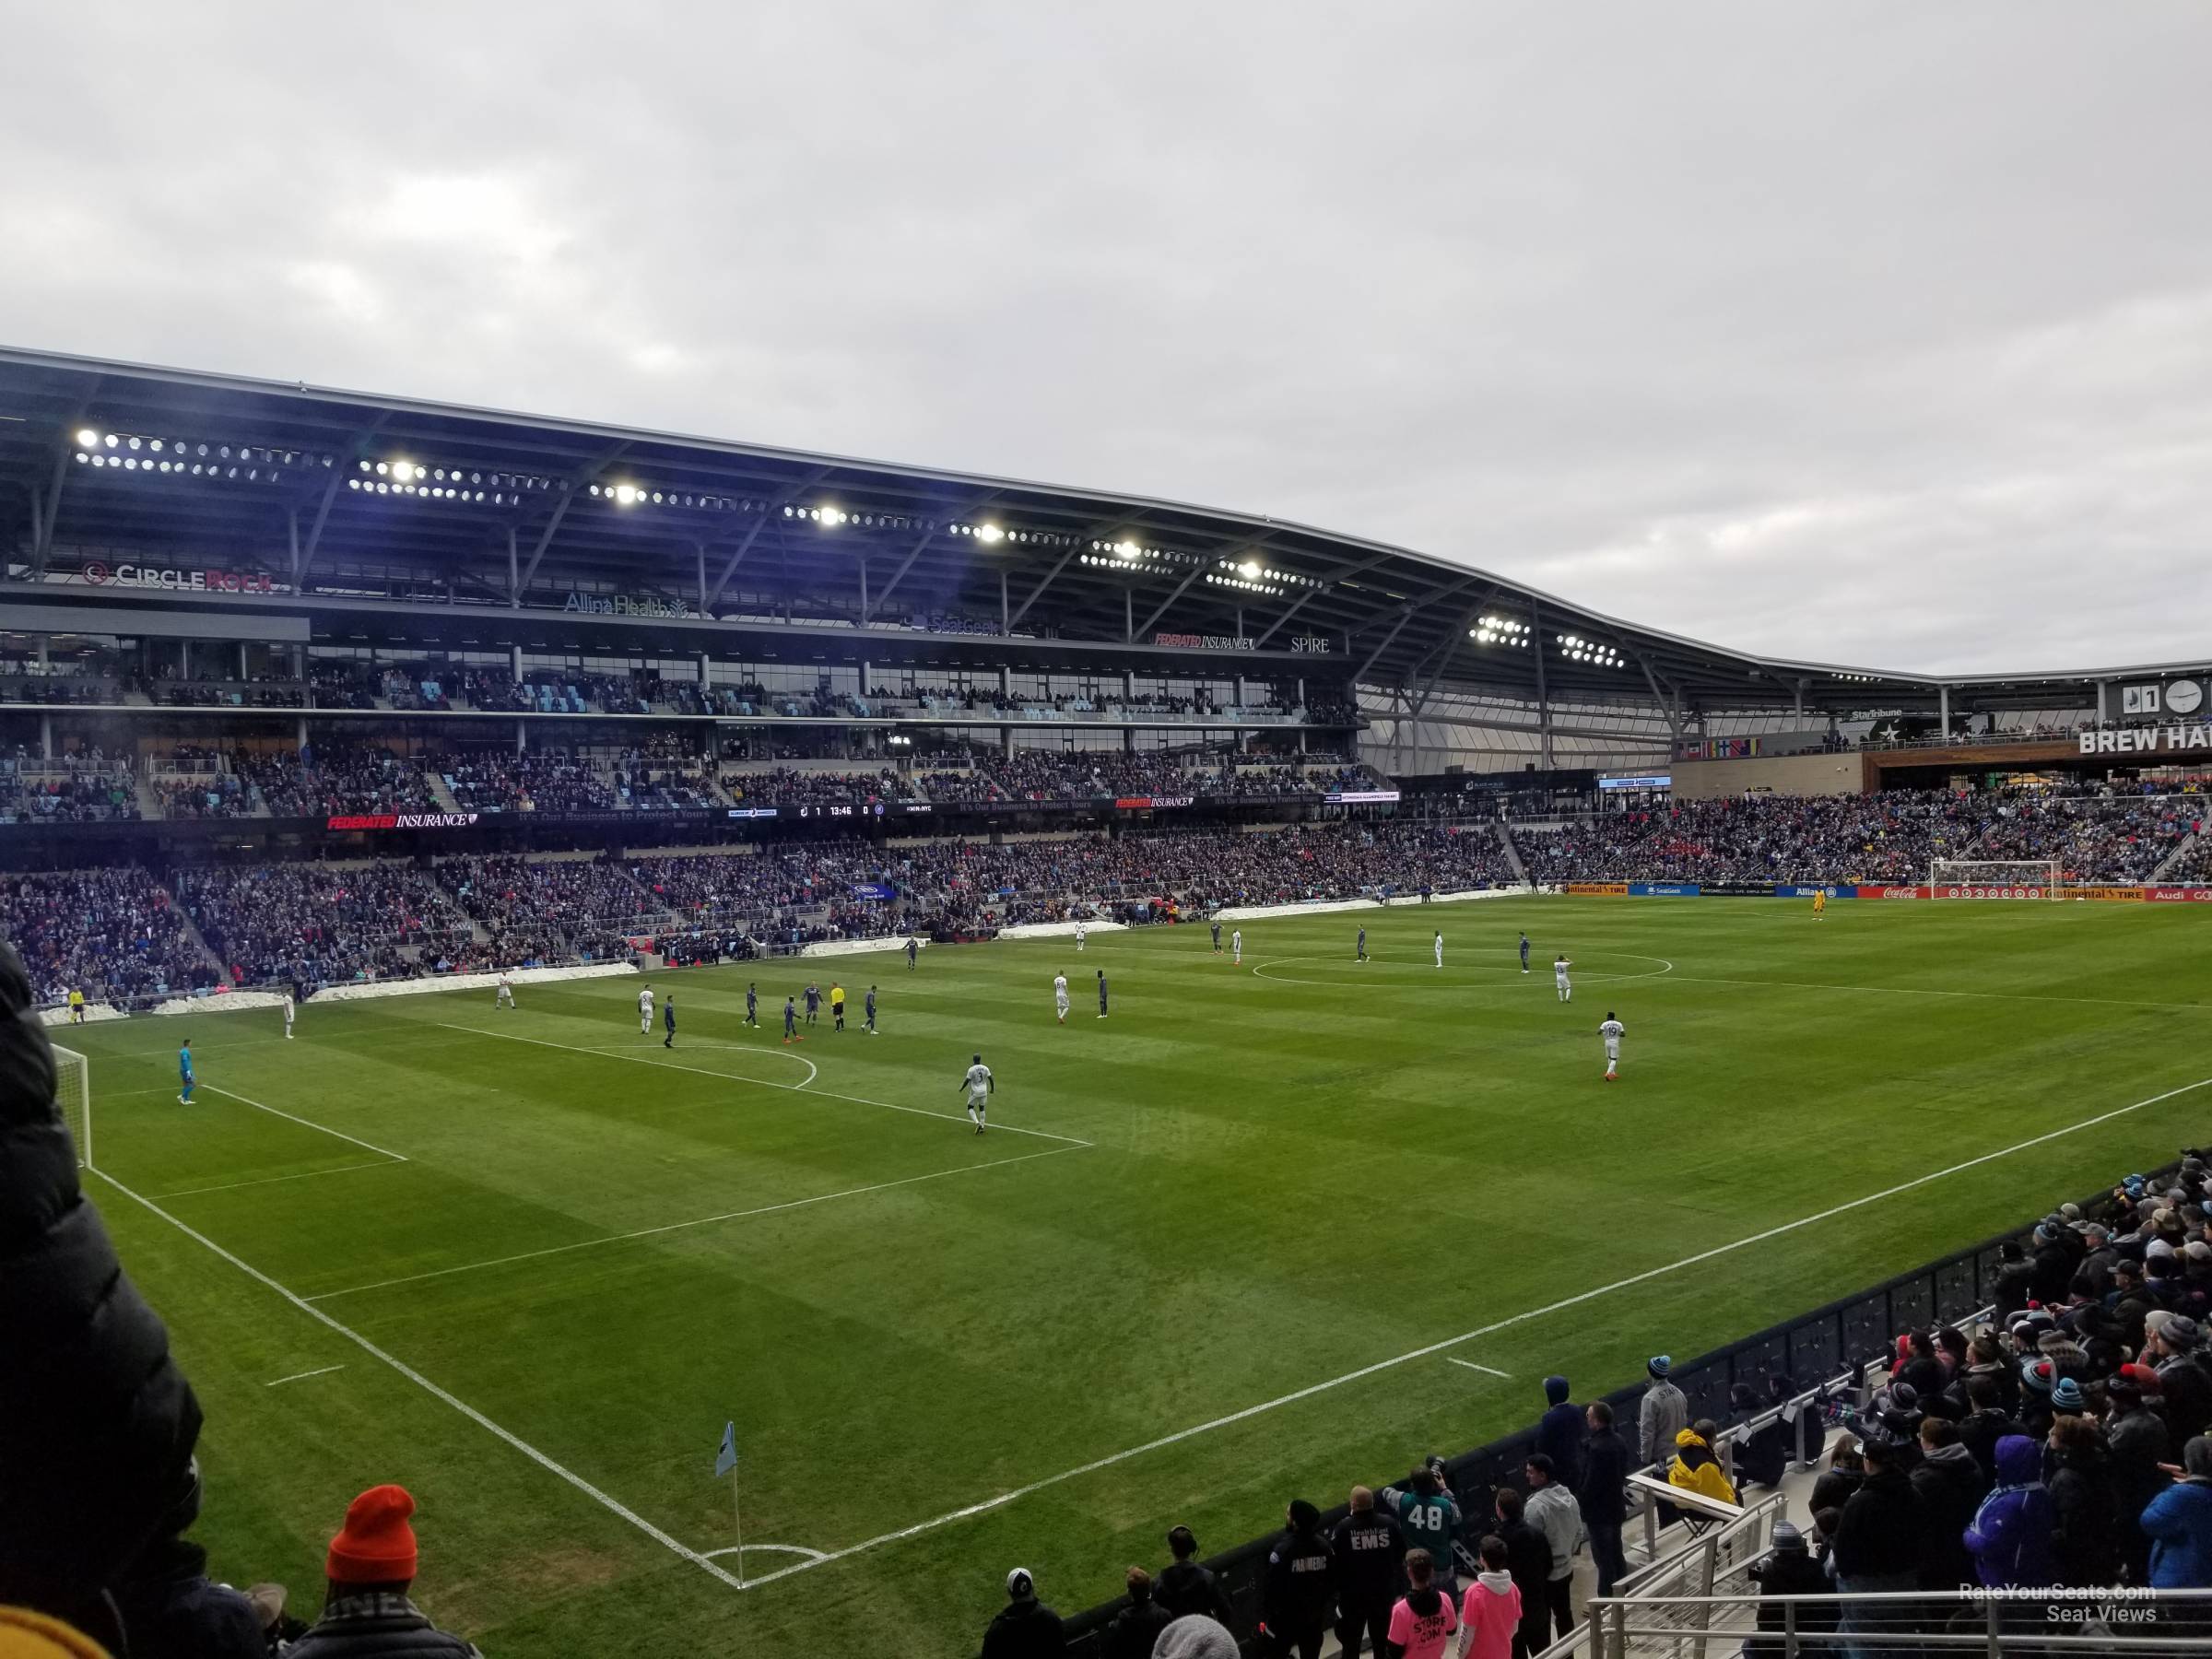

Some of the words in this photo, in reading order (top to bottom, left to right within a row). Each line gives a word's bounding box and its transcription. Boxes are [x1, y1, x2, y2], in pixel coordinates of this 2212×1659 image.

[1156, 633, 1201, 647] FEDERATED
[1201, 636, 1249, 650] INSURANCE
[1291, 637, 1330, 653] SPIRE
[2079, 727, 2159, 754] BREW
[2167, 725, 2212, 749] HA
[975, 801, 990, 811] Our
[992, 801, 1028, 811] Business
[1040, 800, 1068, 809] Protect
[1071, 799, 1091, 808] Yours
[1115, 798, 1152, 808] FEDERATED
[1151, 797, 1188, 807] INSURANCE
[636, 810, 677, 819] Protect
[681, 810, 710, 819] Yours
[816, 807, 820, 816] 1
[830, 806, 852, 816] 13:46
[863, 806, 868, 815] 0
[327, 815, 398, 830] FEDERATED
[396, 814, 466, 828] INSURANCE
[1796, 888, 1818, 896] Allia
[2155, 890, 2184, 900] Audi
[1608, 1027, 1618, 1037] 19
[1407, 1504, 1442, 1531] 48
[1351, 1533, 1391, 1550] EMS
[1413, 1617, 1447, 1633] STORE
